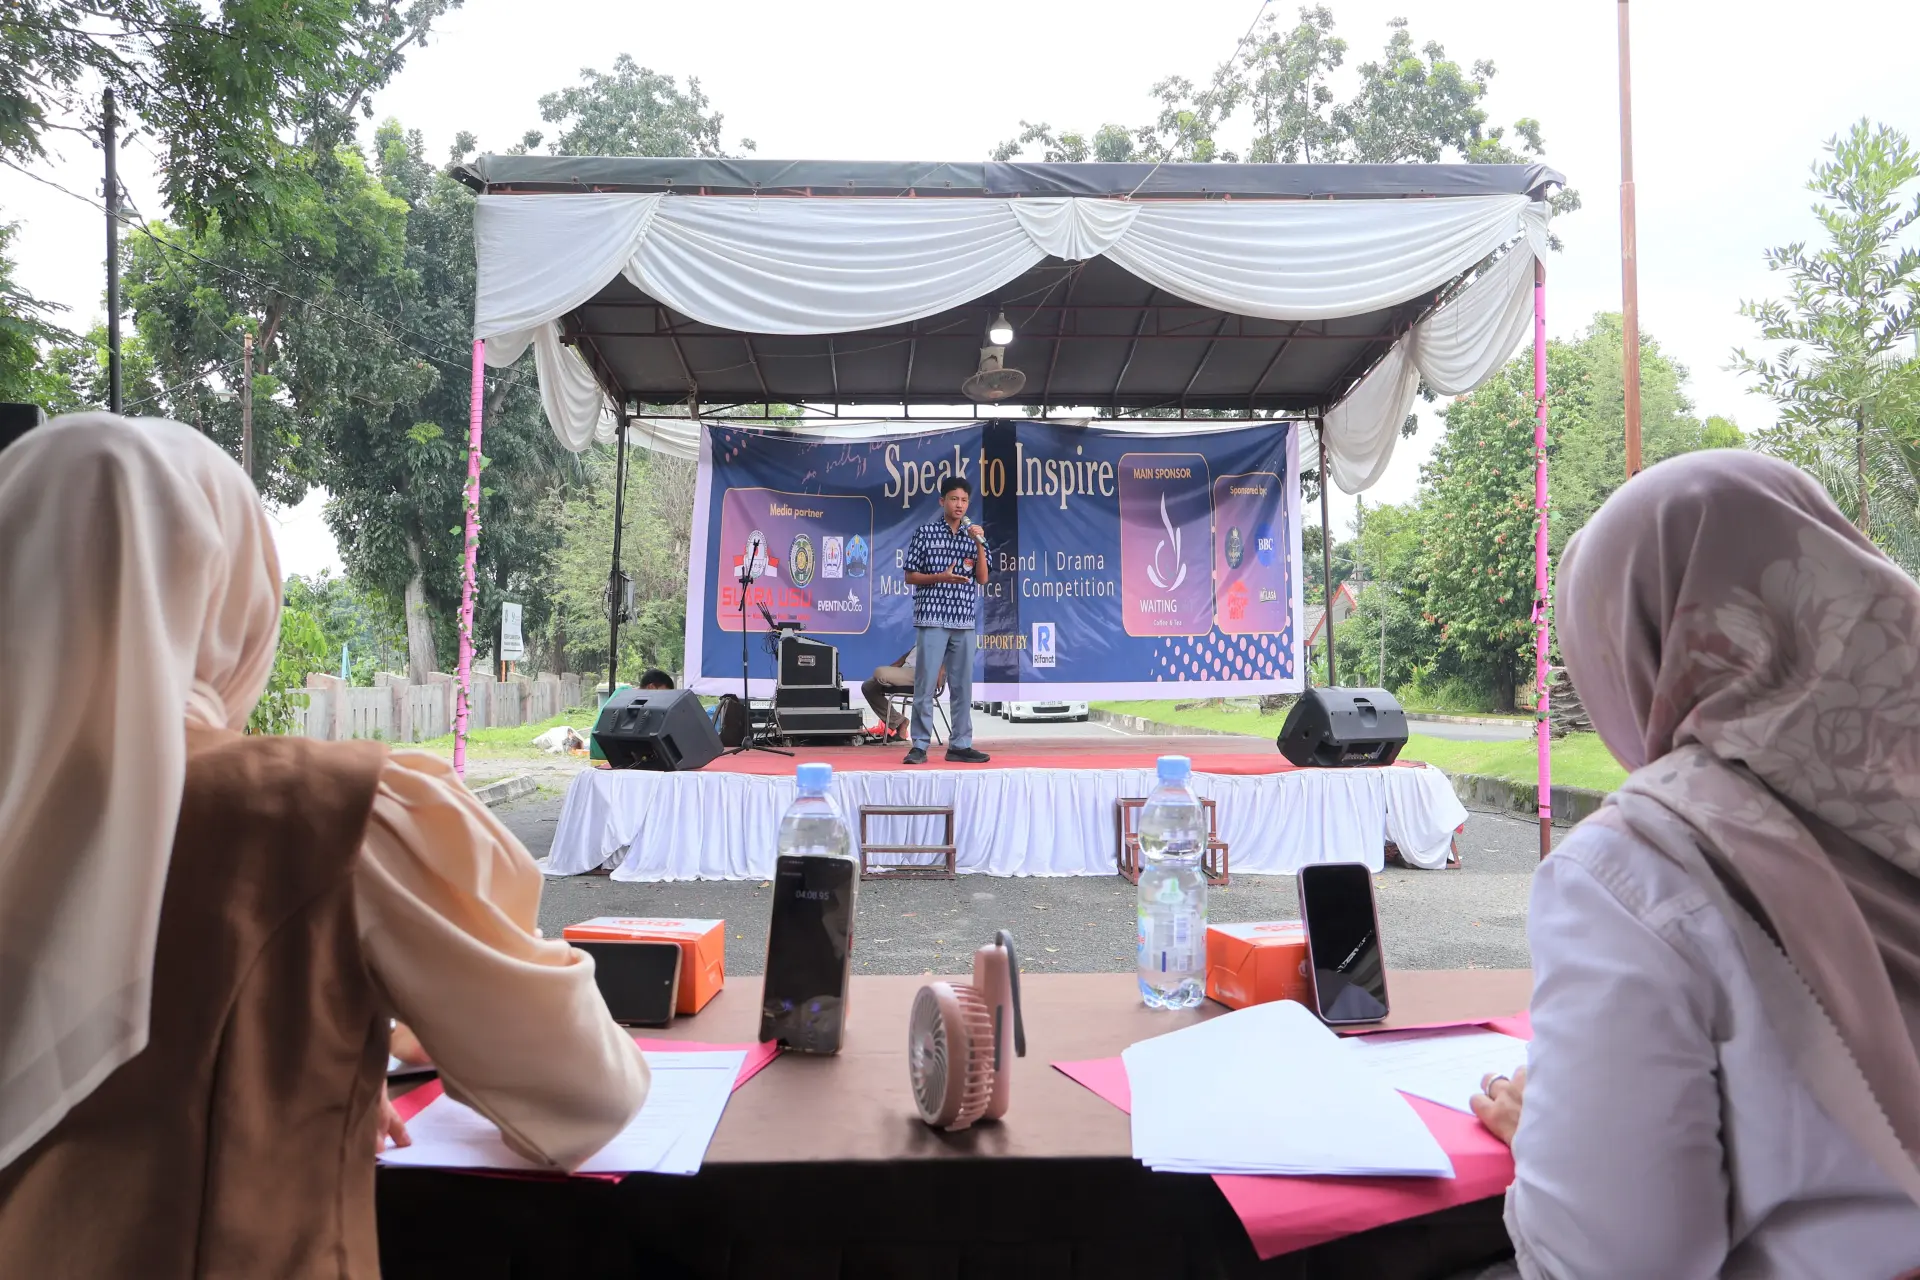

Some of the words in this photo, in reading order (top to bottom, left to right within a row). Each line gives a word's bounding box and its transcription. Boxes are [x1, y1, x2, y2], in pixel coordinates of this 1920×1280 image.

[884, 443, 969, 509] Speak
[979, 447, 1005, 497] to
[1015, 442, 1114, 509] Inspire
[1133, 468, 1153, 479] MAIN
[1155, 467, 1191, 479] SPONSOR
[1229, 484, 1258, 497] Sponsored
[769, 503, 792, 516] Media
[794, 507, 823, 519] partner
[1258, 538, 1273, 550] BBC
[1000, 552, 1036, 571] Band
[1056, 551, 1104, 571] Drama
[722, 586, 774, 607] SUARA
[778, 587, 812, 607] USU
[1022, 577, 1114, 602] Competition
[1139, 599, 1177, 613] WAITING
[976, 634, 1014, 650] UPPORT
[1016, 635, 1028, 650] BY
